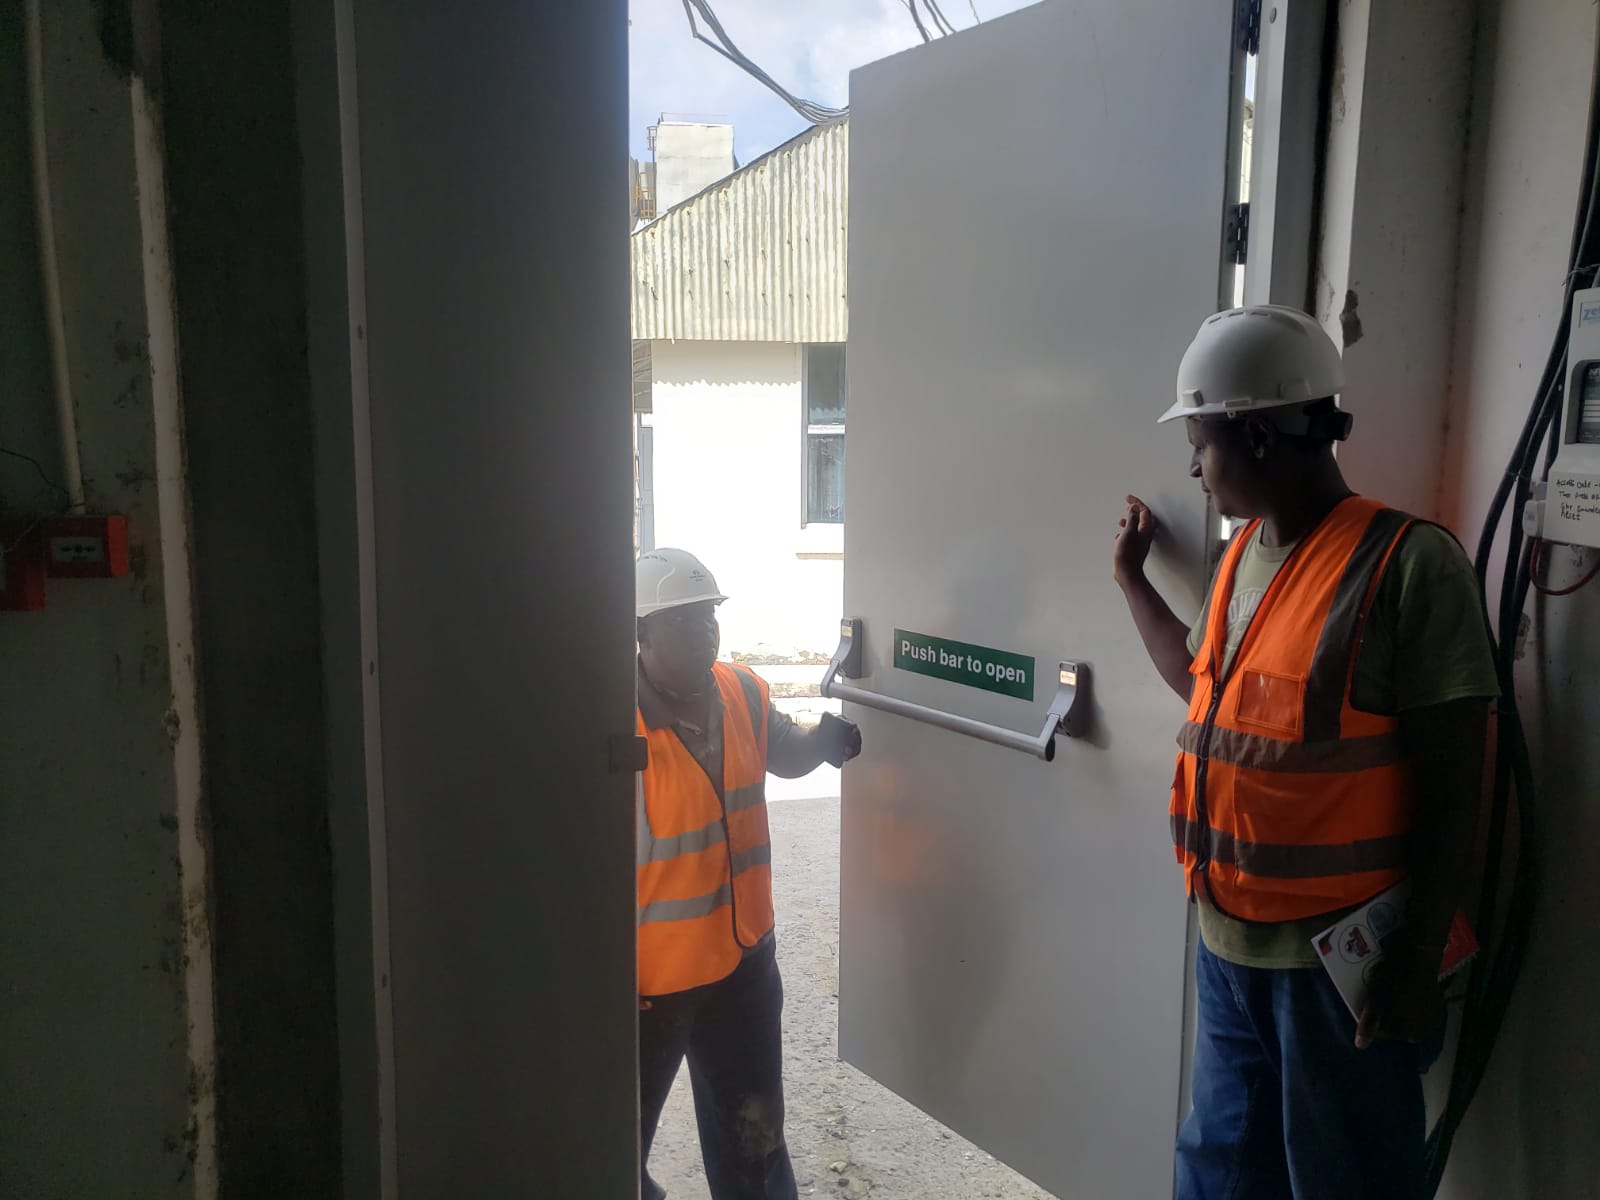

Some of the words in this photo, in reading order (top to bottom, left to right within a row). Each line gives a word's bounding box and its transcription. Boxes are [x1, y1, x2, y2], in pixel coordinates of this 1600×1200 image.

[901, 639, 936, 663] Push
[939, 647, 964, 669] bar
[966, 655, 982, 673] to
[985, 662, 1026, 683] open
